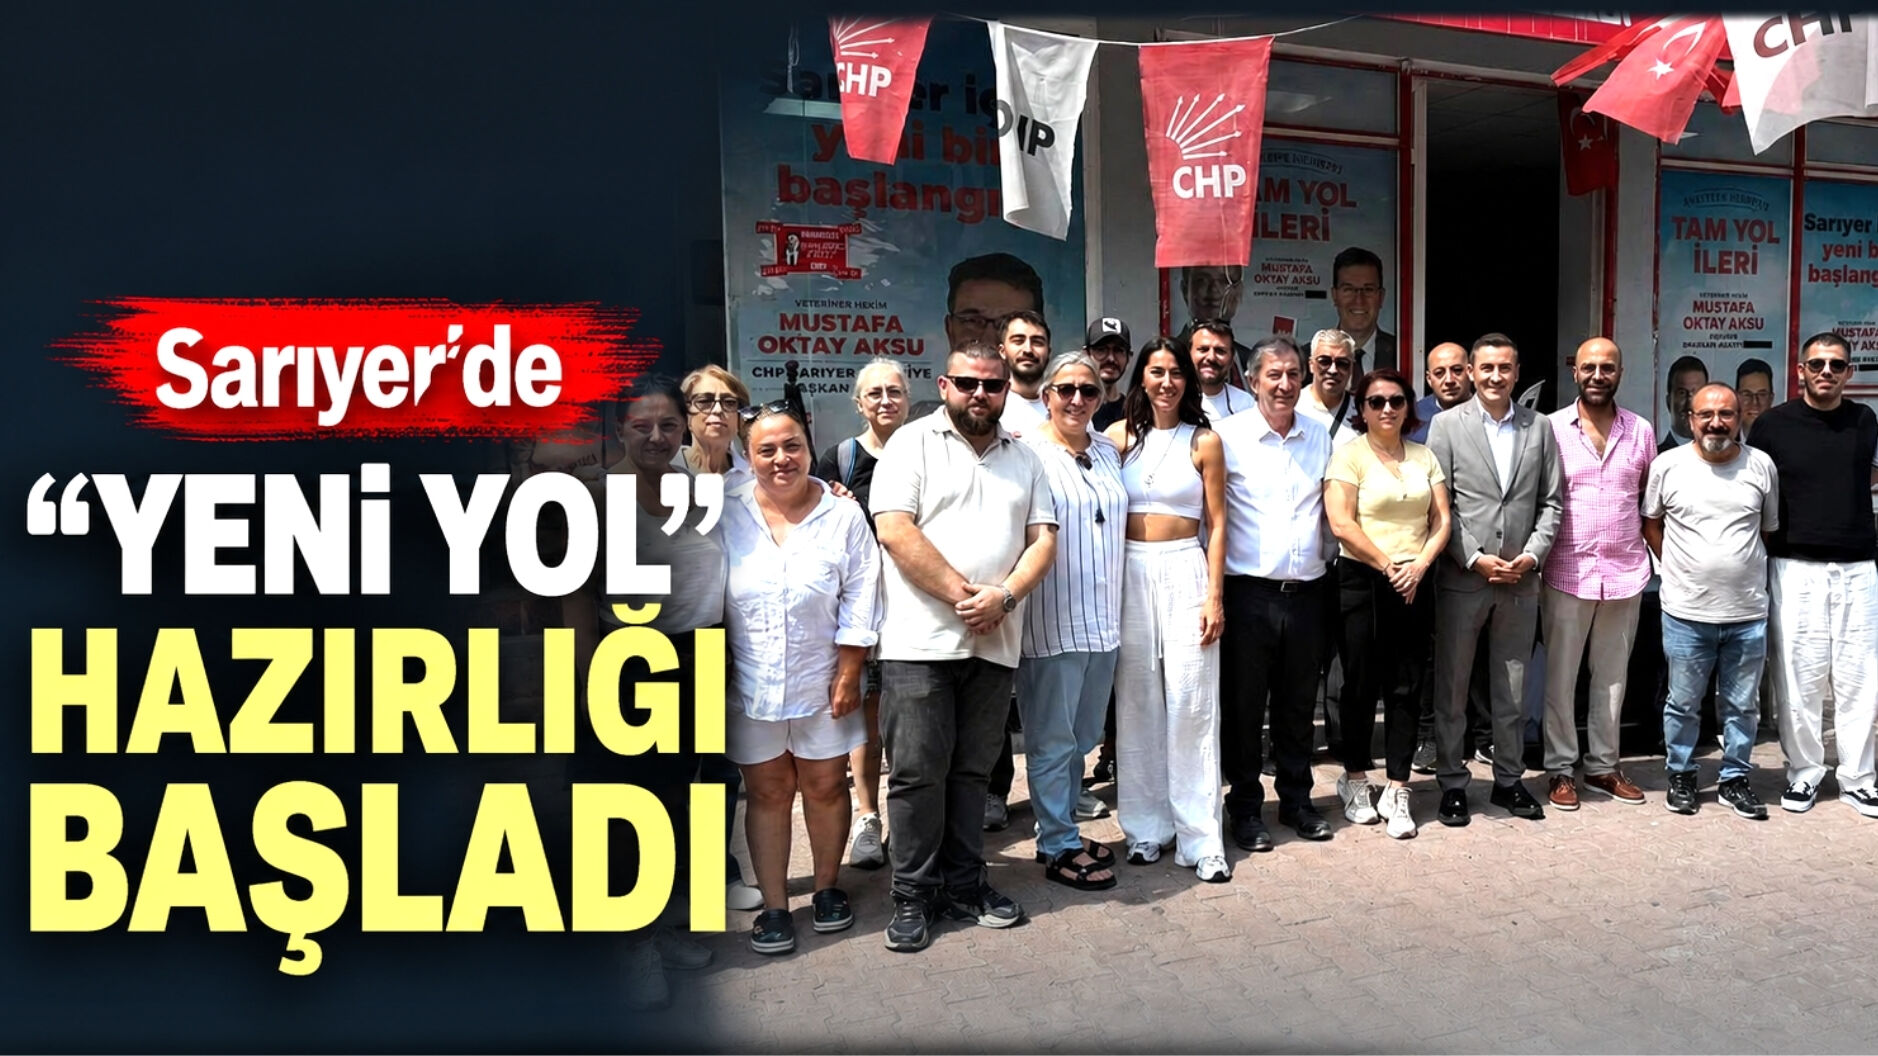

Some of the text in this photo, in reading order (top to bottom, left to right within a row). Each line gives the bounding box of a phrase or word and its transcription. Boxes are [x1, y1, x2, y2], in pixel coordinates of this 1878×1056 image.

[1172, 164, 1247, 199] CHP
[777, 164, 1001, 224] başlangı
[1298, 179, 1358, 208] YOL
[1672, 215, 1781, 244] TAM YOL
[1804, 213, 1873, 237] Sarıyer
[1694, 242, 1758, 275] İLERİ
[1822, 240, 1862, 262] yeni
[1261, 262, 1313, 274] MUSTAFA
[855, 300, 887, 310] HEKİM
[1692, 300, 1755, 314] MUSTAFA
[779, 313, 904, 334] MUSTAFA
[1683, 316, 1764, 330] OKTAY AKSU
[757, 335, 925, 357] OKTAY AKSU
[752, 366, 785, 379] CHP
